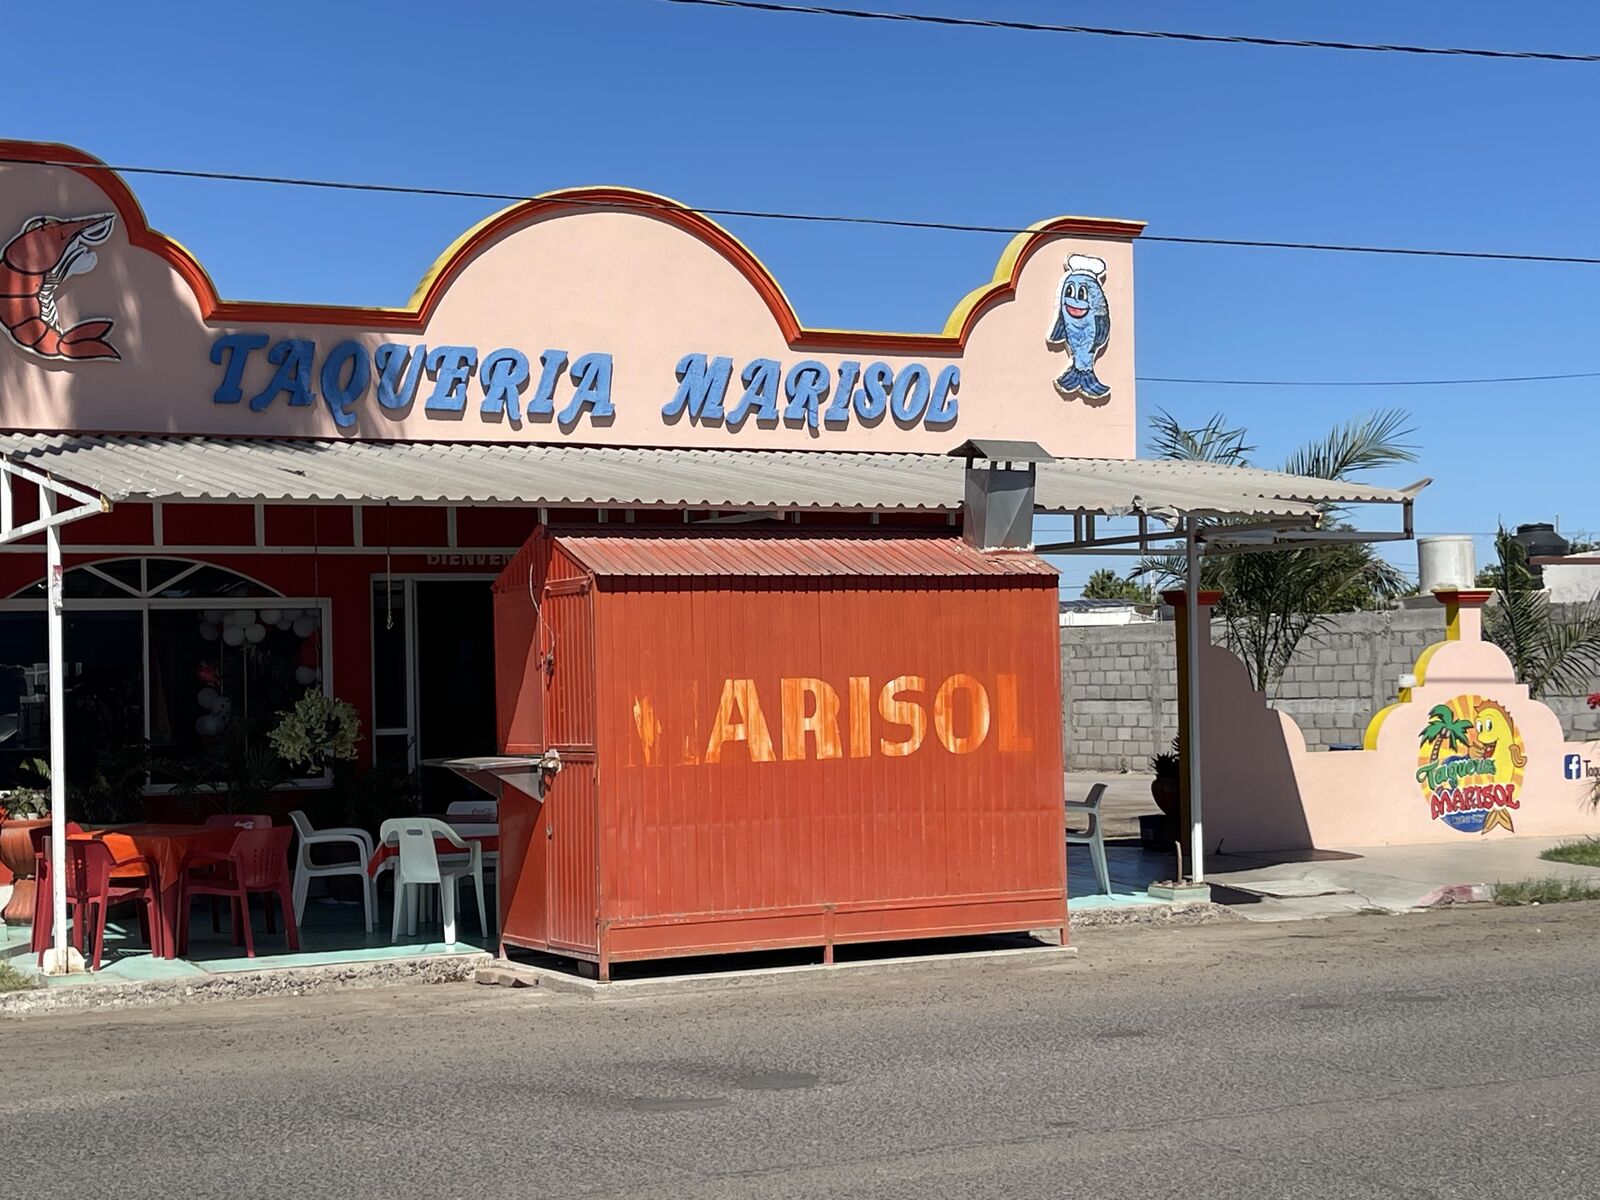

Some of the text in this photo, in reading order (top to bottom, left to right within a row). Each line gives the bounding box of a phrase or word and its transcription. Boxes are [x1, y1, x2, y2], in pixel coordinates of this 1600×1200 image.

[210, 333, 961, 429] TAQUERIA MARISOL
[1431, 784, 1520, 820] MARISOL
